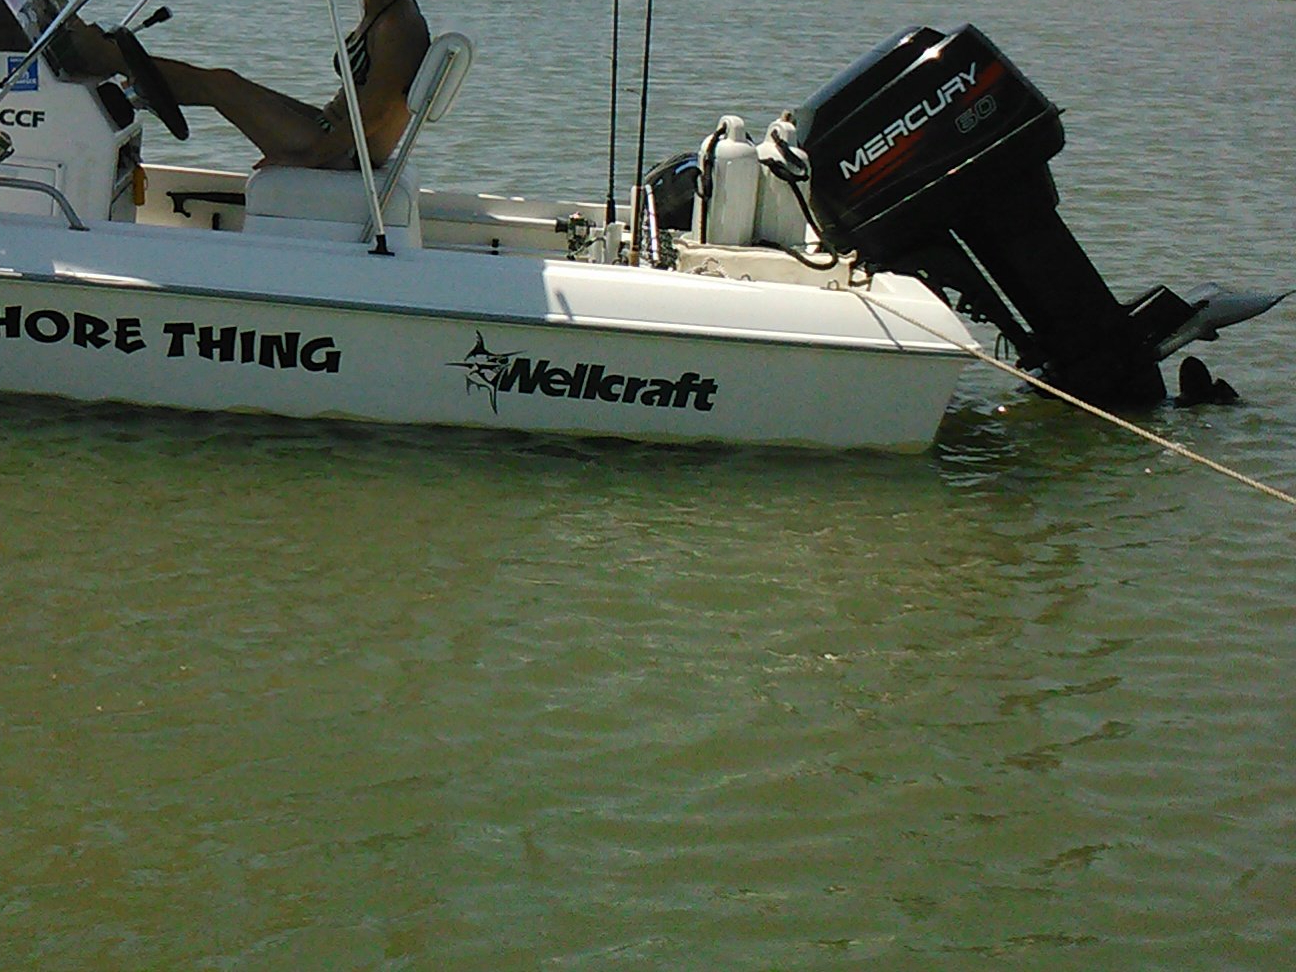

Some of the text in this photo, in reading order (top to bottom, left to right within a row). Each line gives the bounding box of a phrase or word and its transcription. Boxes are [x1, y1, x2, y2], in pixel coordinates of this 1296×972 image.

[839, 61, 977, 180] MERCURY
[163, 322, 342, 374] THING
[498, 357, 718, 412] Wellcraft
